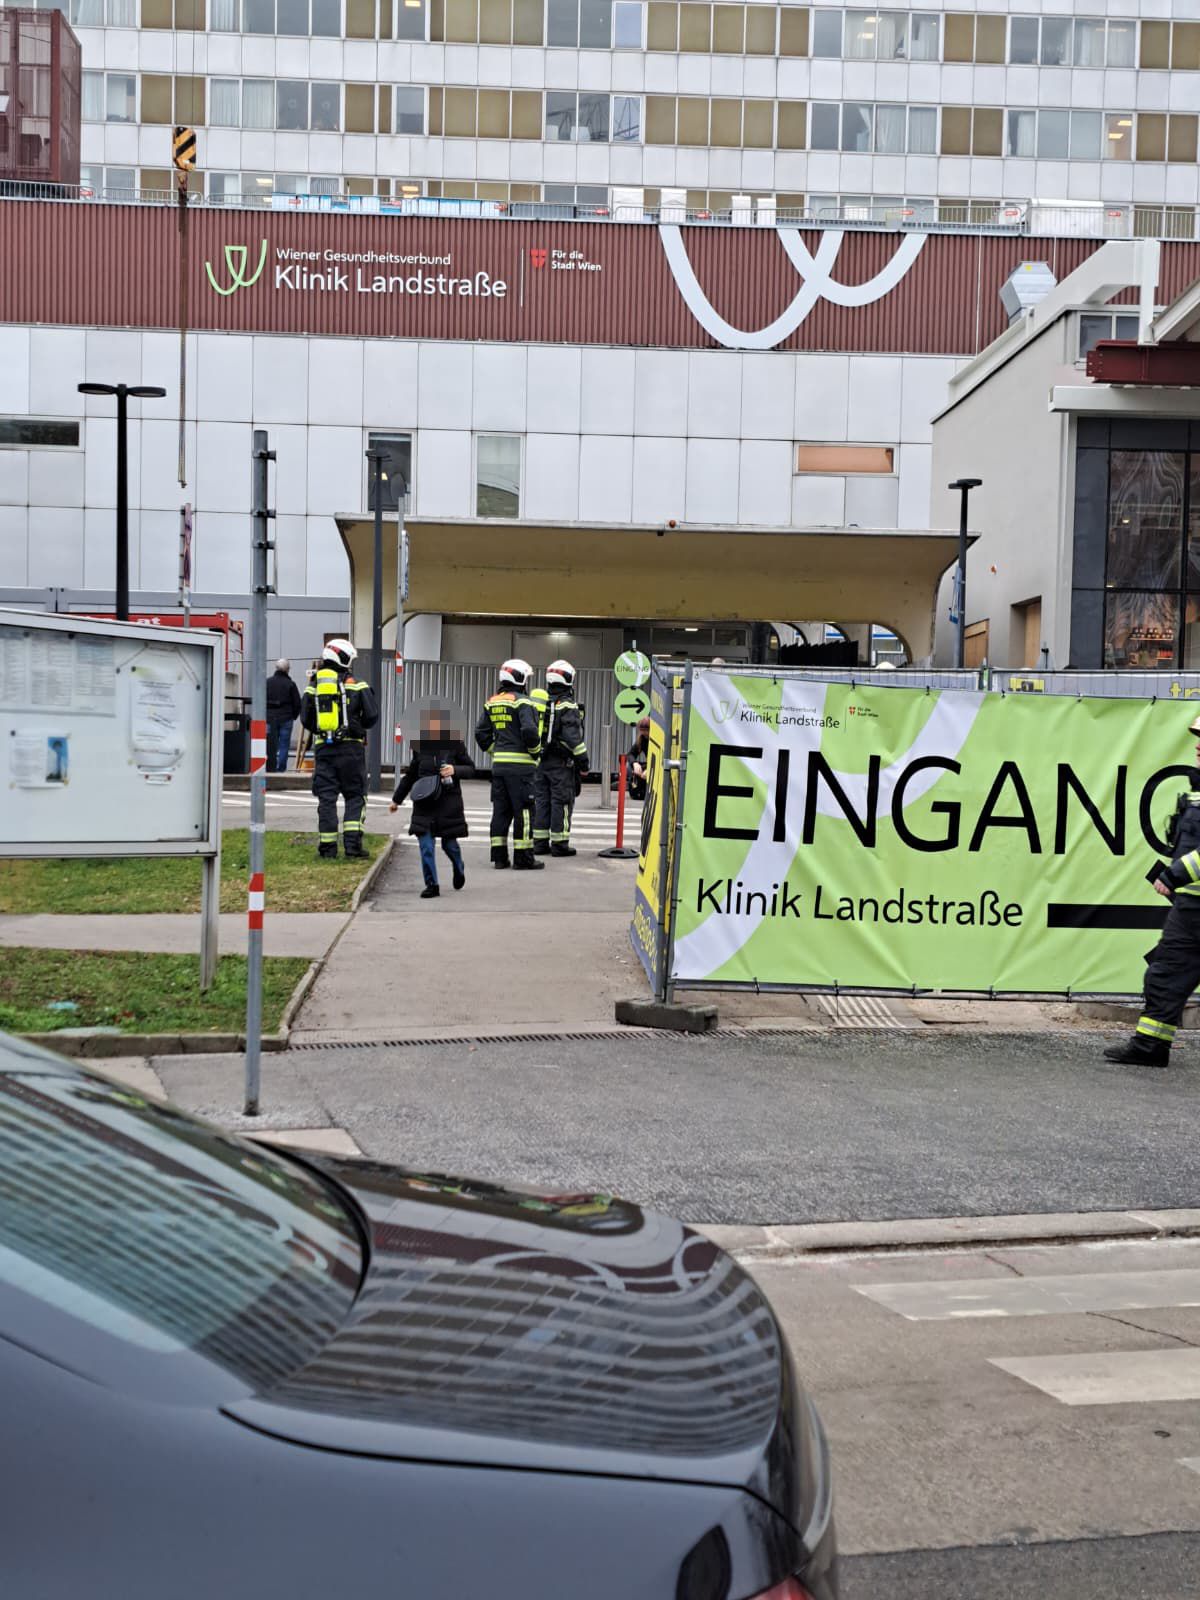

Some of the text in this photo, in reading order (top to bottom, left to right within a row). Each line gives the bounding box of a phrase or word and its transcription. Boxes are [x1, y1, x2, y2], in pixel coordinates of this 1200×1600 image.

[276, 248, 451, 265] Wiener Gesundheitsverbund
[552, 249, 584, 260] Für die
[551, 260, 602, 271] Stadt Wien
[275, 265, 507, 297] Klinik Landstraße
[740, 710, 772, 724] Klinik
[776, 713, 840, 729] Landstraße
[697, 878, 801, 918] Klinik
[814, 885, 1023, 926] Landstraße
